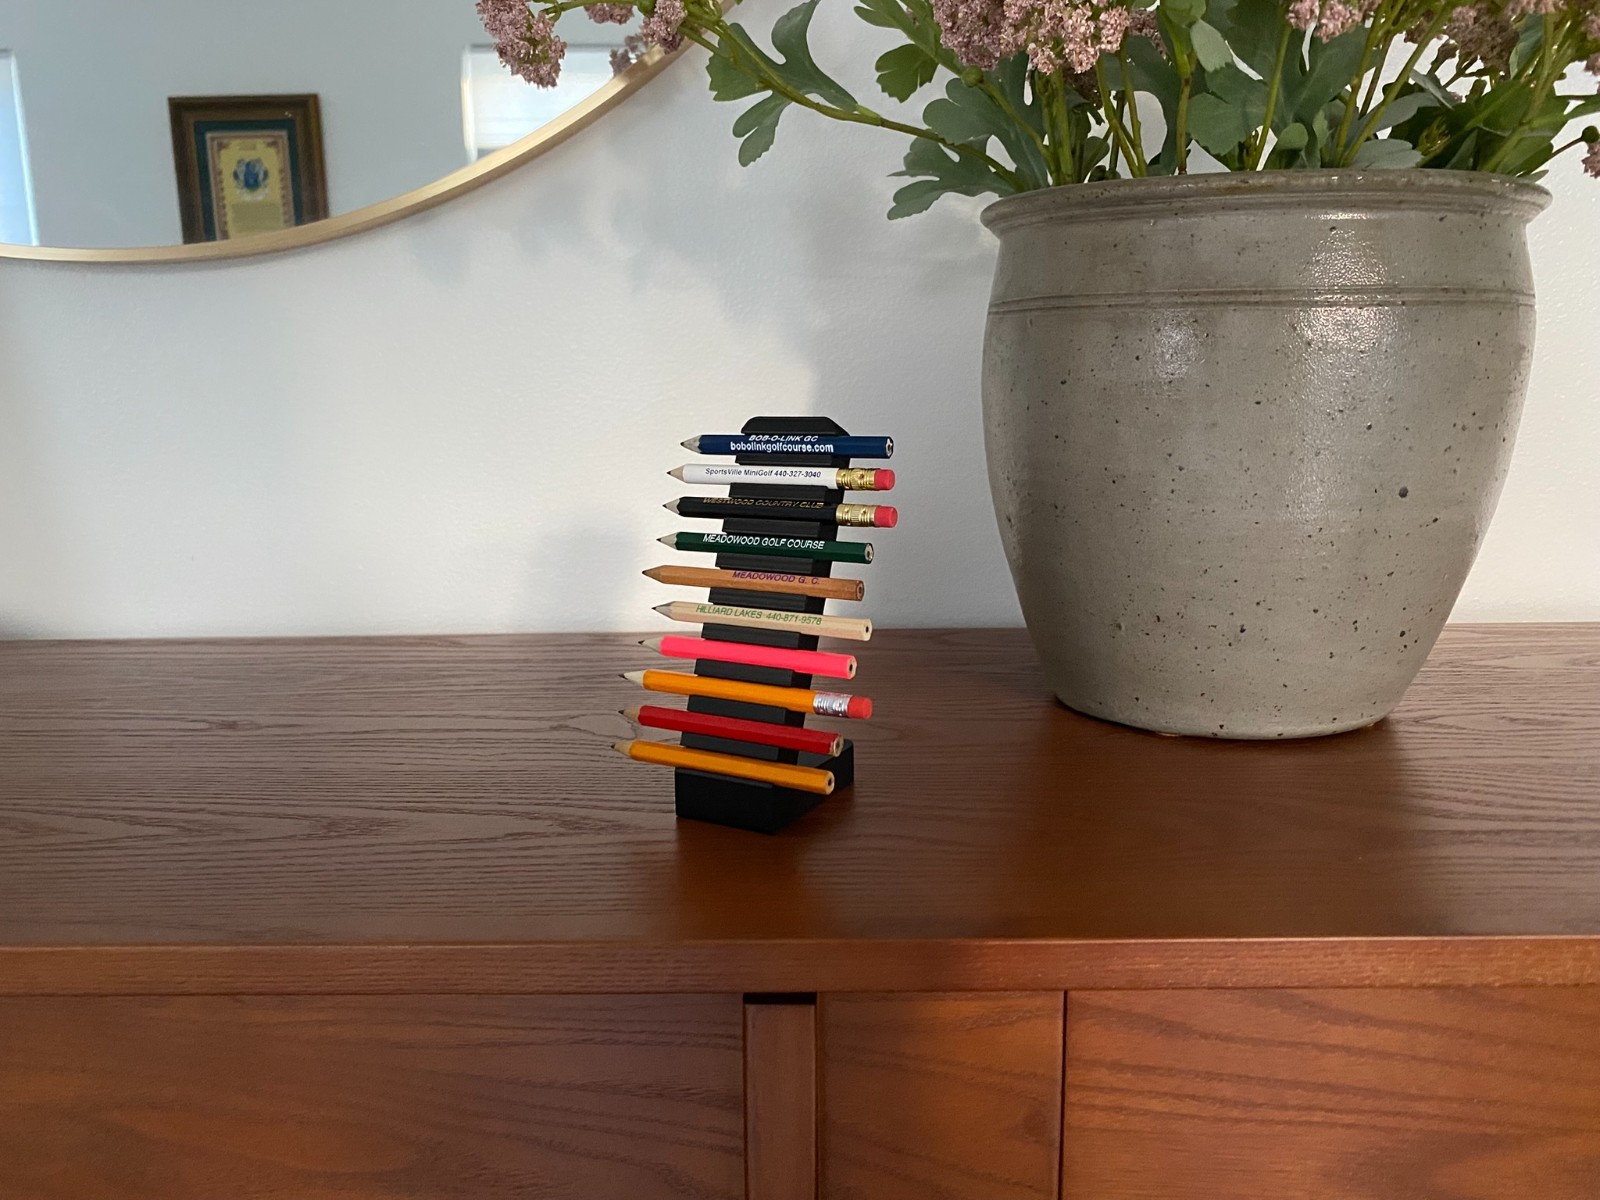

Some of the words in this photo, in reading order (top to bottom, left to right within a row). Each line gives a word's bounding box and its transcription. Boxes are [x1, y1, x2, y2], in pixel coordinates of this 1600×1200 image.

[730, 441, 834, 453] bobolinkgolfcourse.com
[705, 468, 742, 477] SportsVille
[744, 469, 773, 477] MiniGolf
[774, 470, 822, 478] 440-327-3040
[703, 497, 755, 506] WESTWOOD
[755, 499, 799, 507] COUNTRY
[799, 501, 824, 509] CLUB
[702, 534, 760, 546] MEADOWOOD
[762, 537, 786, 547] GOLF
[787, 538, 825, 550] COURSE
[732, 571, 795, 583] MEADOWOOD
[798, 575, 807, 584] G.
[811, 576, 820, 585] C.
[695, 605, 733, 616] HILLIARD
[734, 608, 762, 619] LAKES
[766, 612, 822, 625] 440-871-9578
